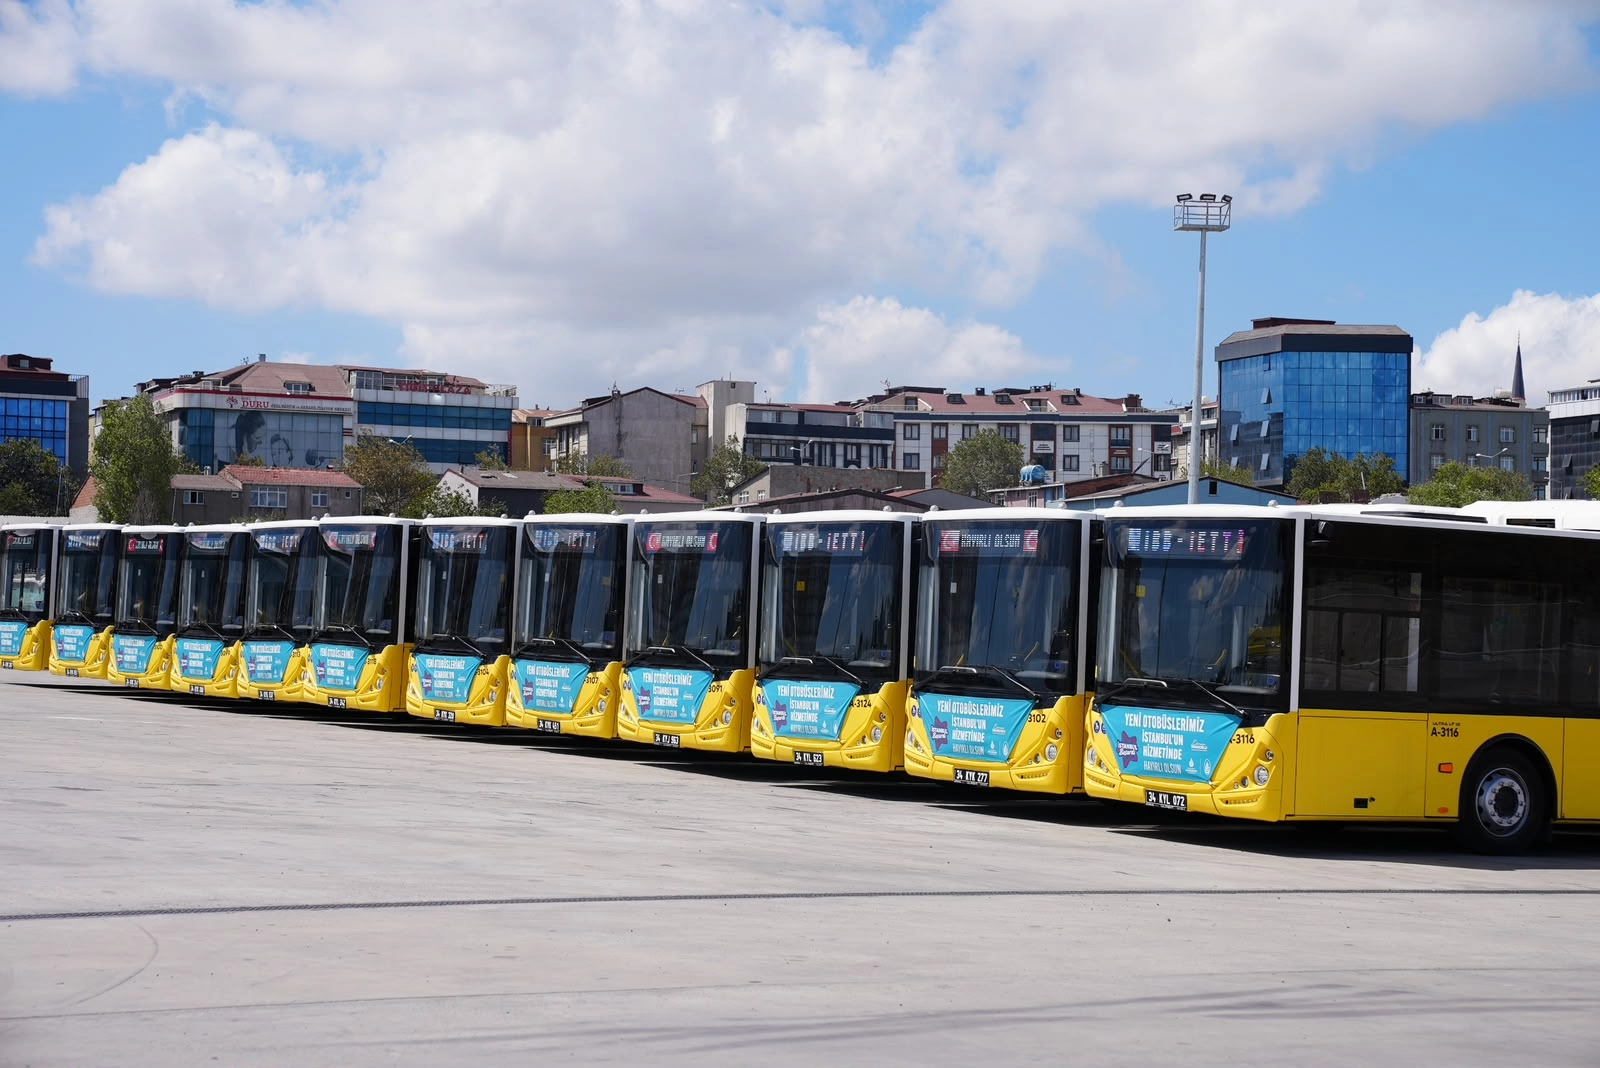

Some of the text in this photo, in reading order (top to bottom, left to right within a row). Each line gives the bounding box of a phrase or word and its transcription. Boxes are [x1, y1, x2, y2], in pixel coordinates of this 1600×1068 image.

[242, 400, 270, 408] DURU
[961, 534, 1020, 548] HAYIRLI OLSUN
[778, 684, 790, 696] YENİ
[938, 698, 1004, 718] YENİ OTOBÜSLERİMİZ
[952, 714, 986, 730] İSTANBUL'UN
[1124, 712, 1204, 732] YENİ OTOBÜSLERİMİZ
[656, 734, 660, 742] 34
[952, 728, 984, 742] HİZMETİNDE
[1142, 729, 1184, 746] İSTANBUL'UN
[1430, 726, 1458, 738] A-3116
[796, 752, 802, 760] 34
[804, 752, 812, 762] KYL
[1142, 744, 1182, 760] HİZMETİNDE
[1144, 760, 1163, 772] HAYIRLI
[1164, 762, 1182, 774] OLSUN
[956, 770, 988, 782] 34 KYK 277
[1148, 790, 1156, 802] 34
[1158, 793, 1170, 804] KYL
[1172, 794, 1184, 806] 072
